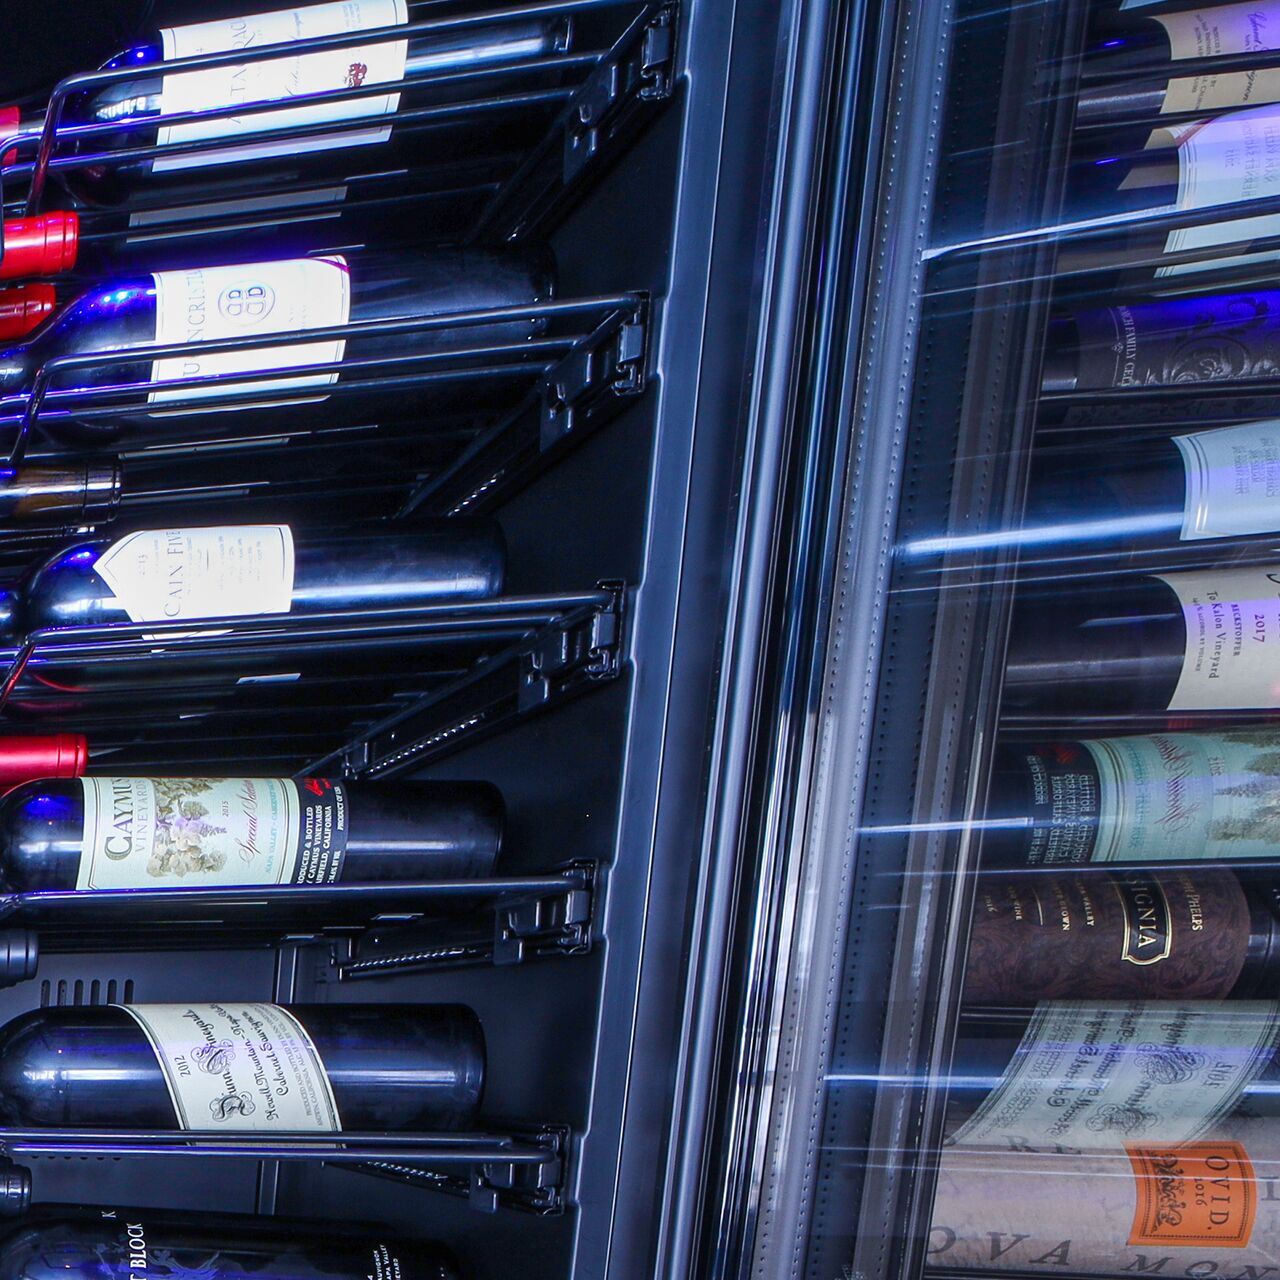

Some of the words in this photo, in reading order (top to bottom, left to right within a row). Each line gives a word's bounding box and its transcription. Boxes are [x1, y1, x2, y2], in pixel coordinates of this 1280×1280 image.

[1124, 327, 1138, 361] FAMILY
[163, 564, 183, 618] CAIN
[1206, 591, 1219, 602] To
[1210, 602, 1225, 630] Kalon
[1230, 603, 1243, 657] BECKSTOFFER
[1251, 613, 1266, 644] 2017
[1208, 631, 1228, 680] Vineyard
[135, 778, 149, 853] VINEYARDS
[221, 799, 230, 818] 2015
[305, 806, 314, 840] BOTTLED
[311, 804, 323, 846] VINEYARDS
[320, 805, 333, 849] CALIFORNIA
[234, 809, 262, 863] Special
[307, 847, 321, 879] CAYMUS
[1185, 894, 1204, 932] PHELPS
[182, 1009, 237, 1075] Vineyards
[241, 1010, 273, 1052] Sauvignon
[174, 1055, 192, 1078] 2012
[244, 1040, 269, 1085] Mountain
[265, 1051, 289, 1097] Cabernet
[208, 1071, 256, 1123] Dunn
[256, 1084, 280, 1121] Howell
[125, 1222, 147, 1269] BLOCK
[379, 1244, 390, 1265] VALLEY
